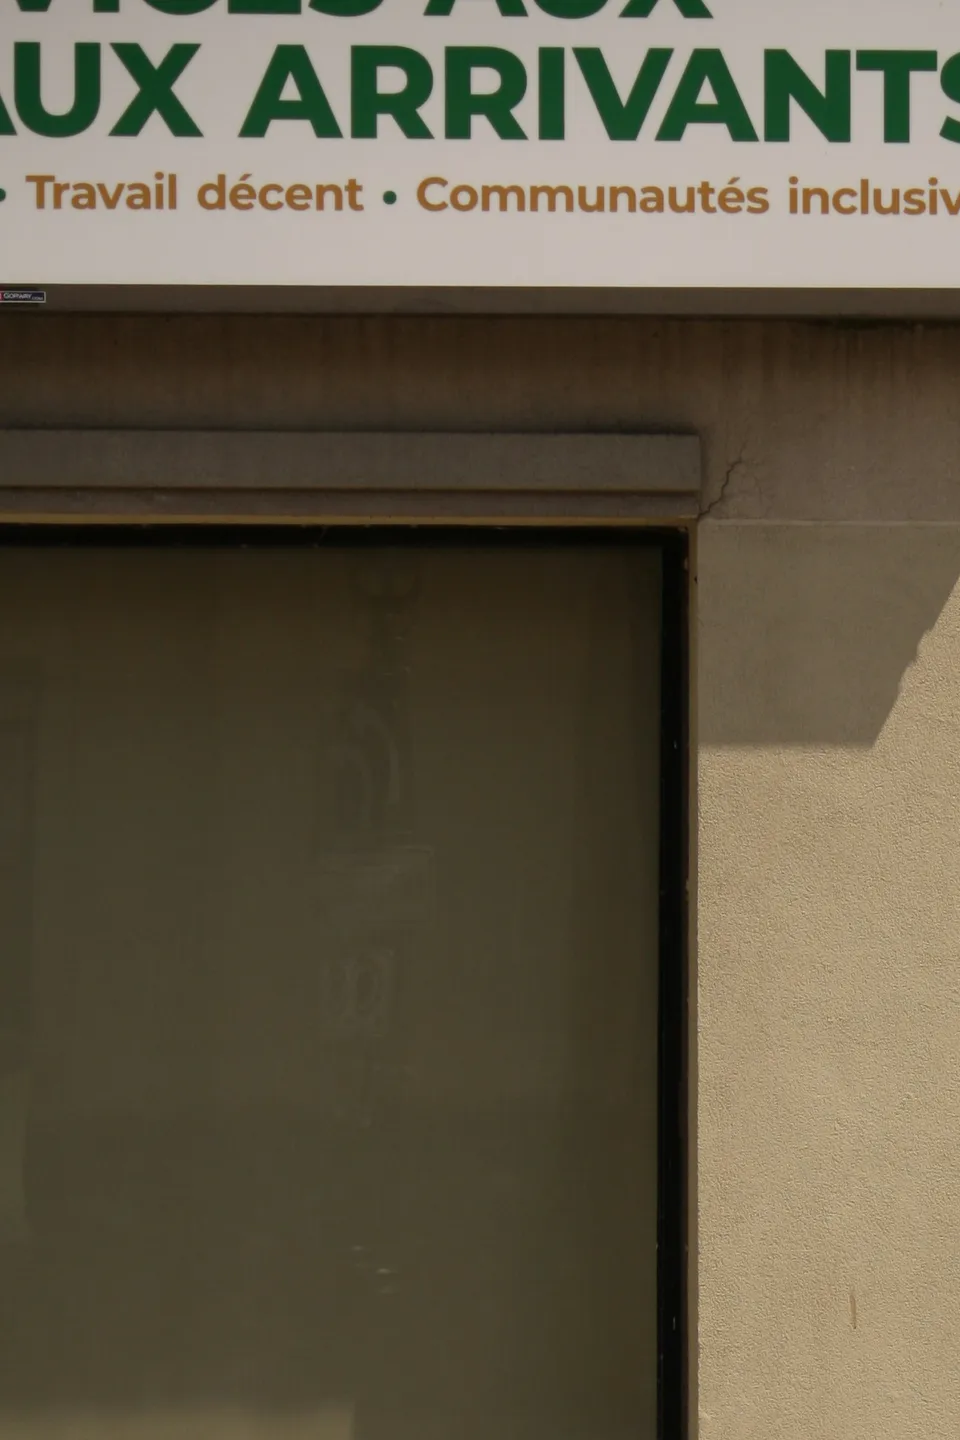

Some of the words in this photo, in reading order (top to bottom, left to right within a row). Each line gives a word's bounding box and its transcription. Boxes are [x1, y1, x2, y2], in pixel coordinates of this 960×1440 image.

[0, 41, 204, 138] UX
[25, 171, 178, 210] Travail
[196, 171, 364, 212] décent
[415, 176, 770, 214] Communautés
